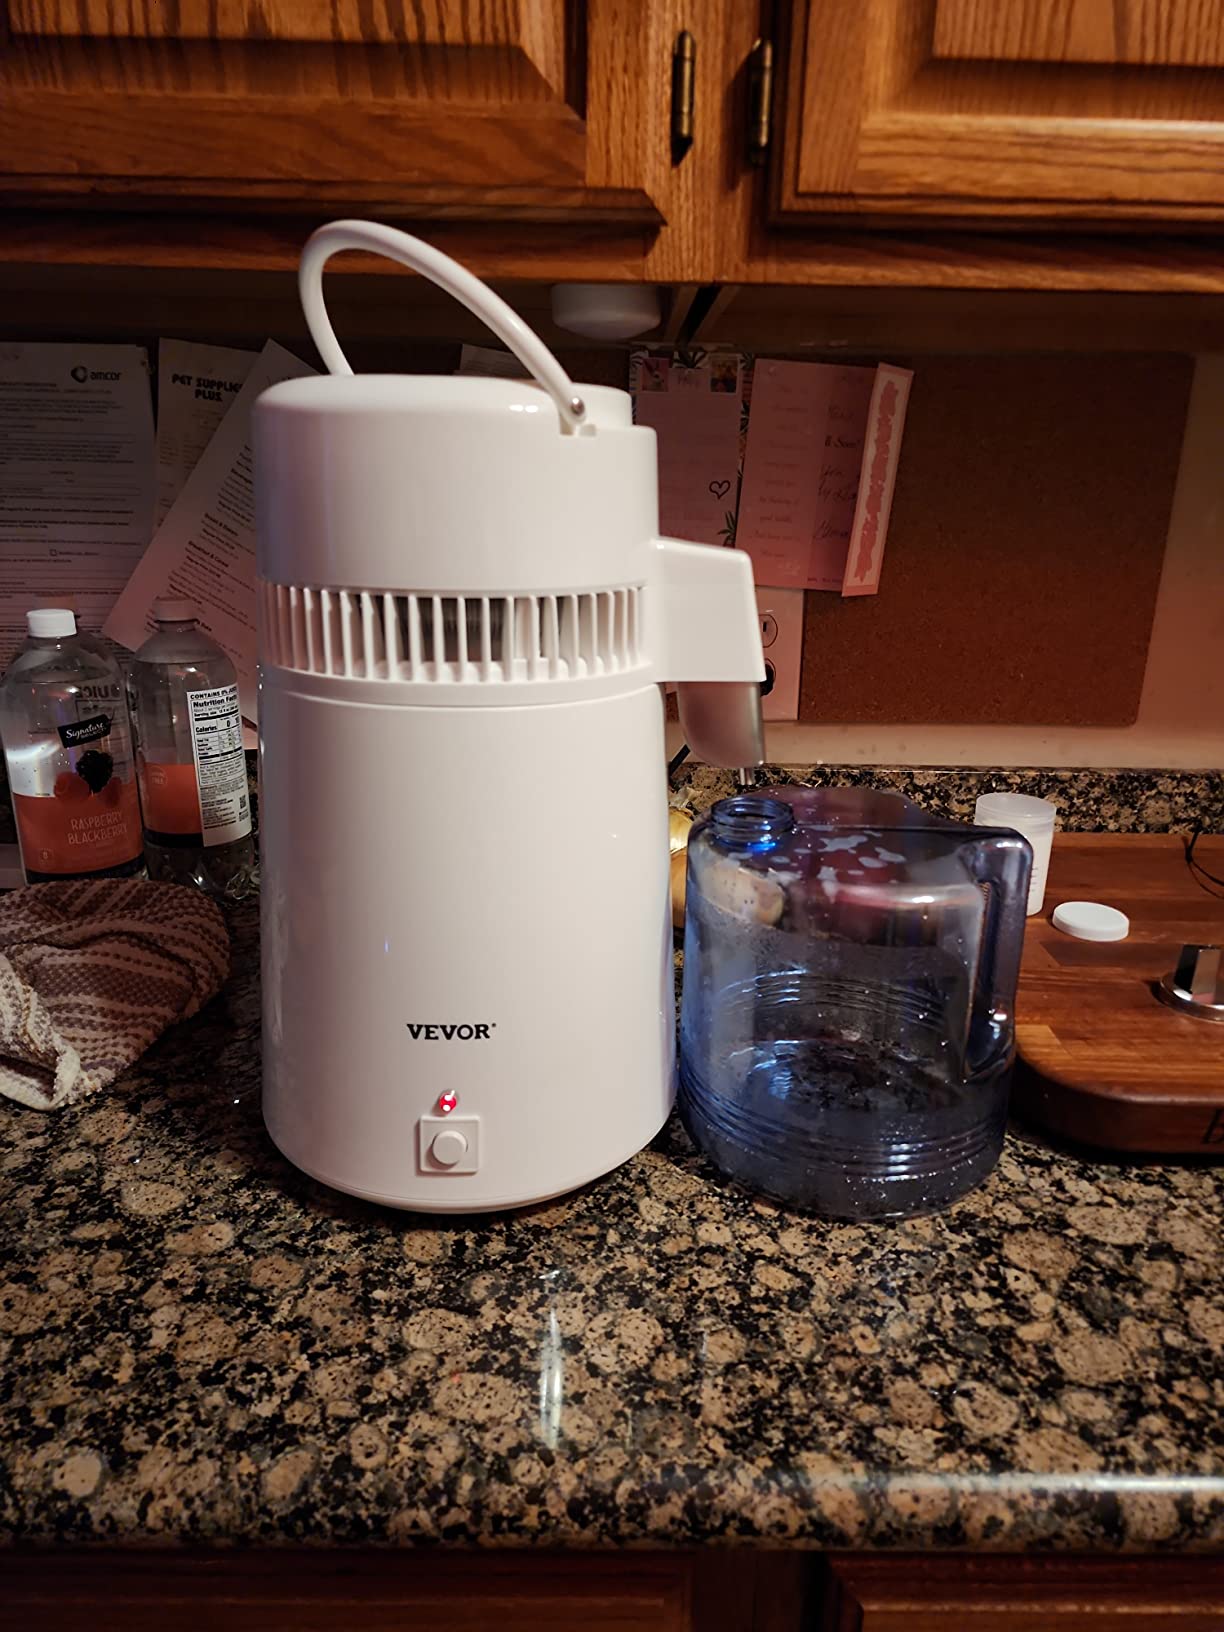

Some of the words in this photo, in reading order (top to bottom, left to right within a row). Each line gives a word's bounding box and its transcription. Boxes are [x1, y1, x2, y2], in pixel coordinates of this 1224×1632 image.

[89, 371, 122, 381] amcor
[172, 373, 193, 386] PET
[196, 377, 243, 393] SUPPLIE
[195, 388, 223, 402] PLUS
[193, 698, 225, 708] Nutrition
[65, 722, 104, 741] Signature
[70, 810, 123, 831] RASPBERRY
[67, 822, 128, 846] BLACKBERRY
[406, 1023, 490, 1041] VEVOR
